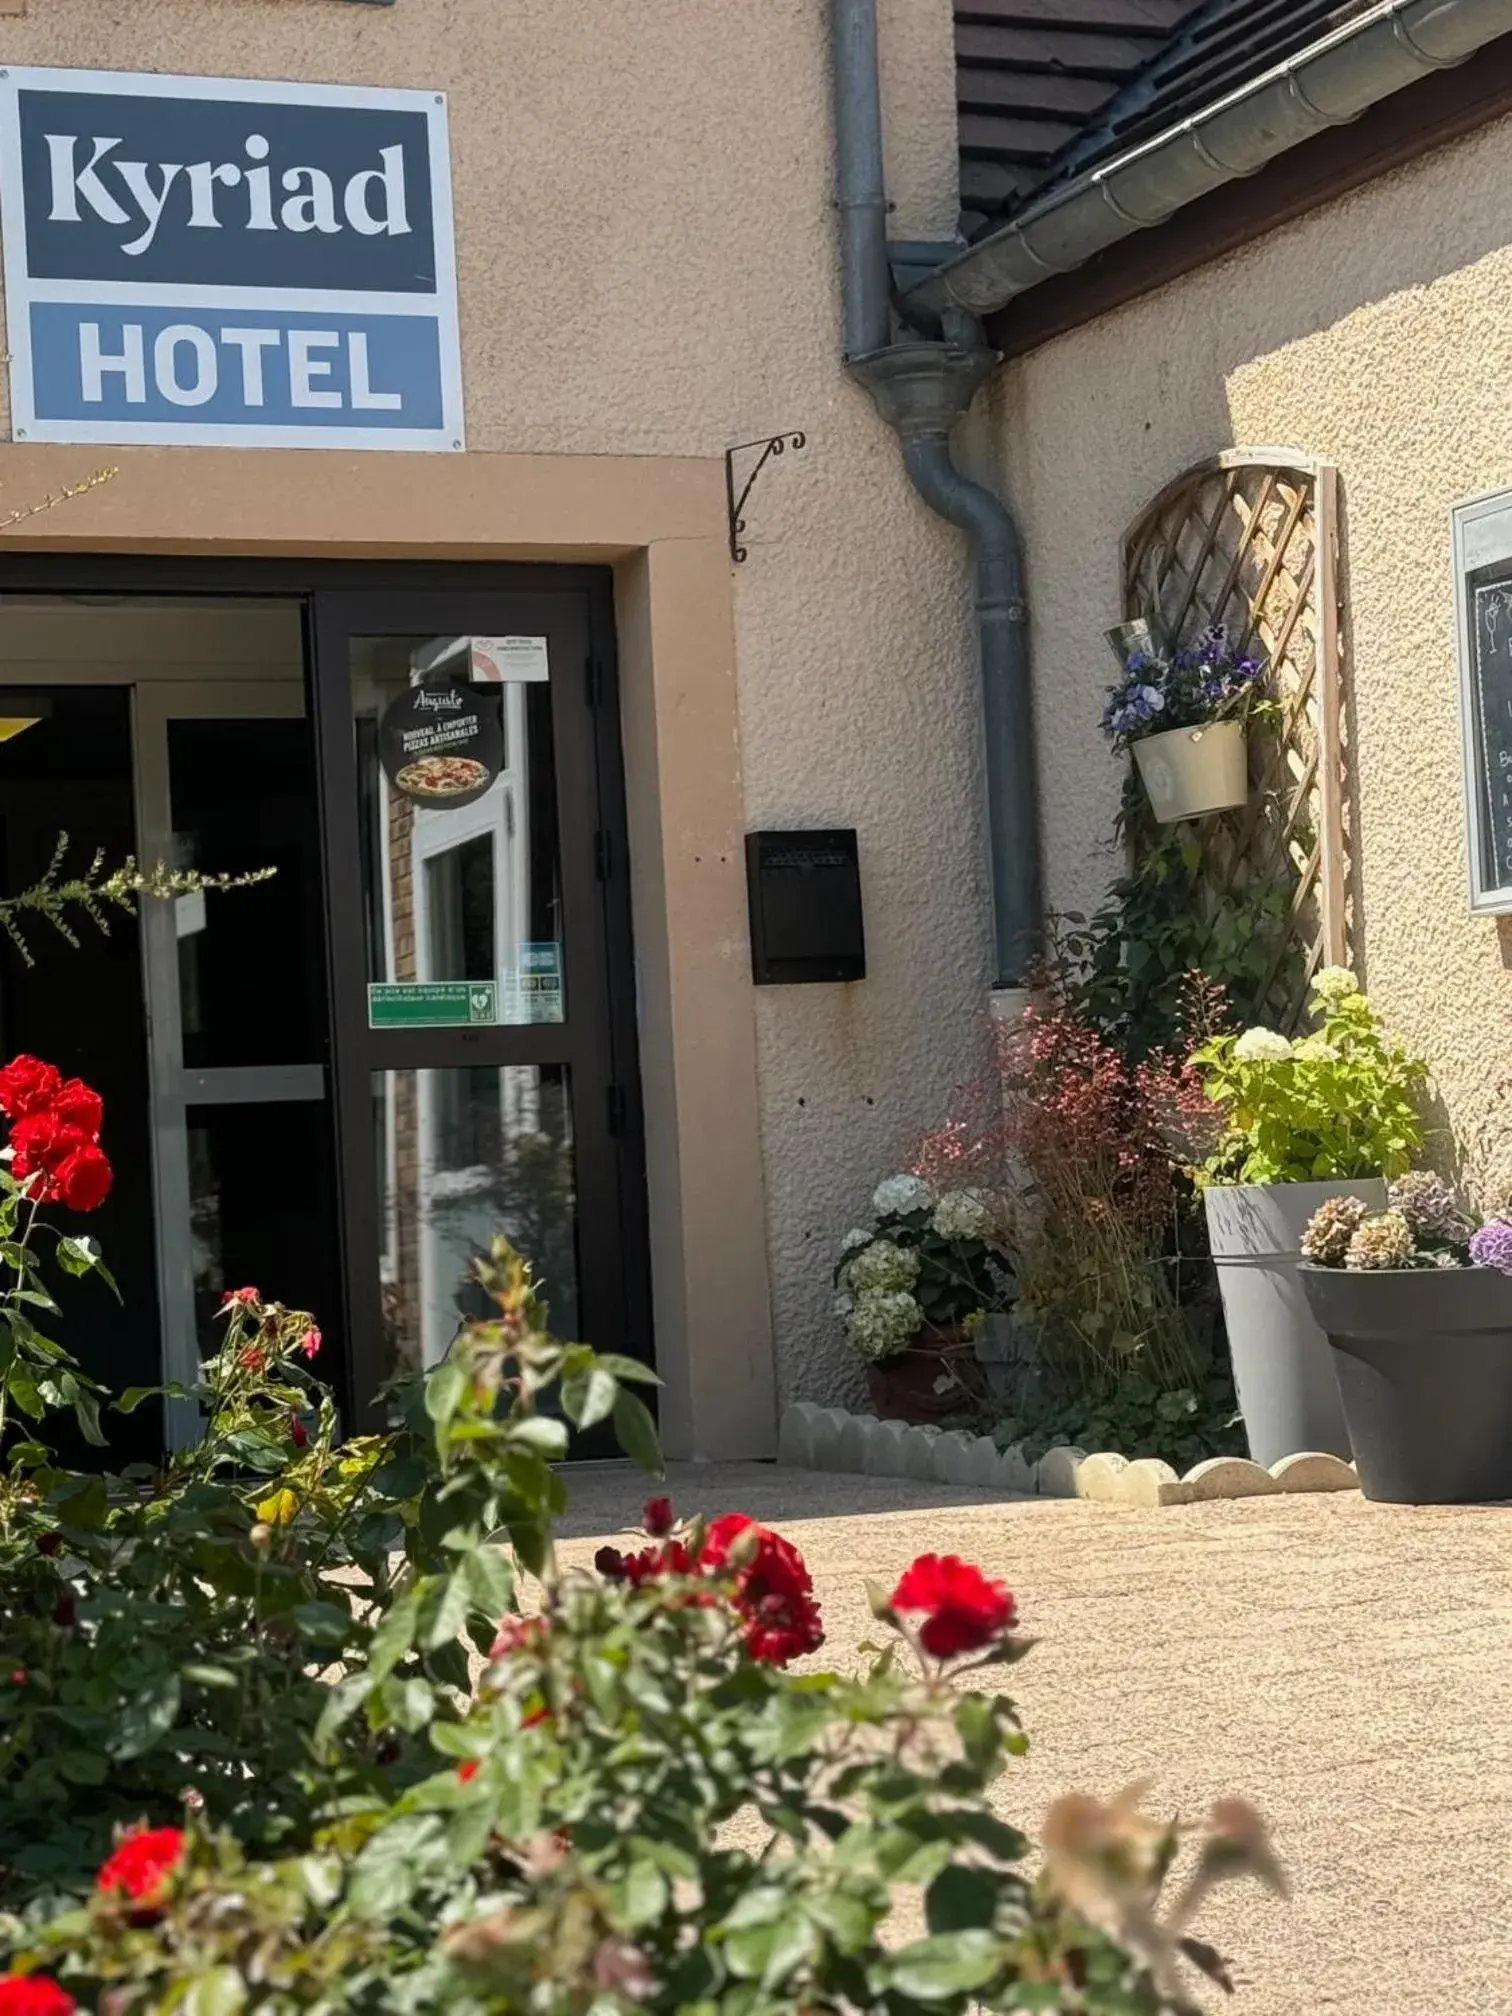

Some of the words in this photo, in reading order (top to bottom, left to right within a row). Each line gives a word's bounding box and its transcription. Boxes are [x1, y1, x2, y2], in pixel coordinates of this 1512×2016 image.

[43, 134, 412, 256] Kyriad
[78, 322, 402, 411] HOTEL
[413, 689, 463, 712] Augusto
[403, 736, 429, 753] PIZZAS
[429, 724, 479, 746] ARTISANALES
